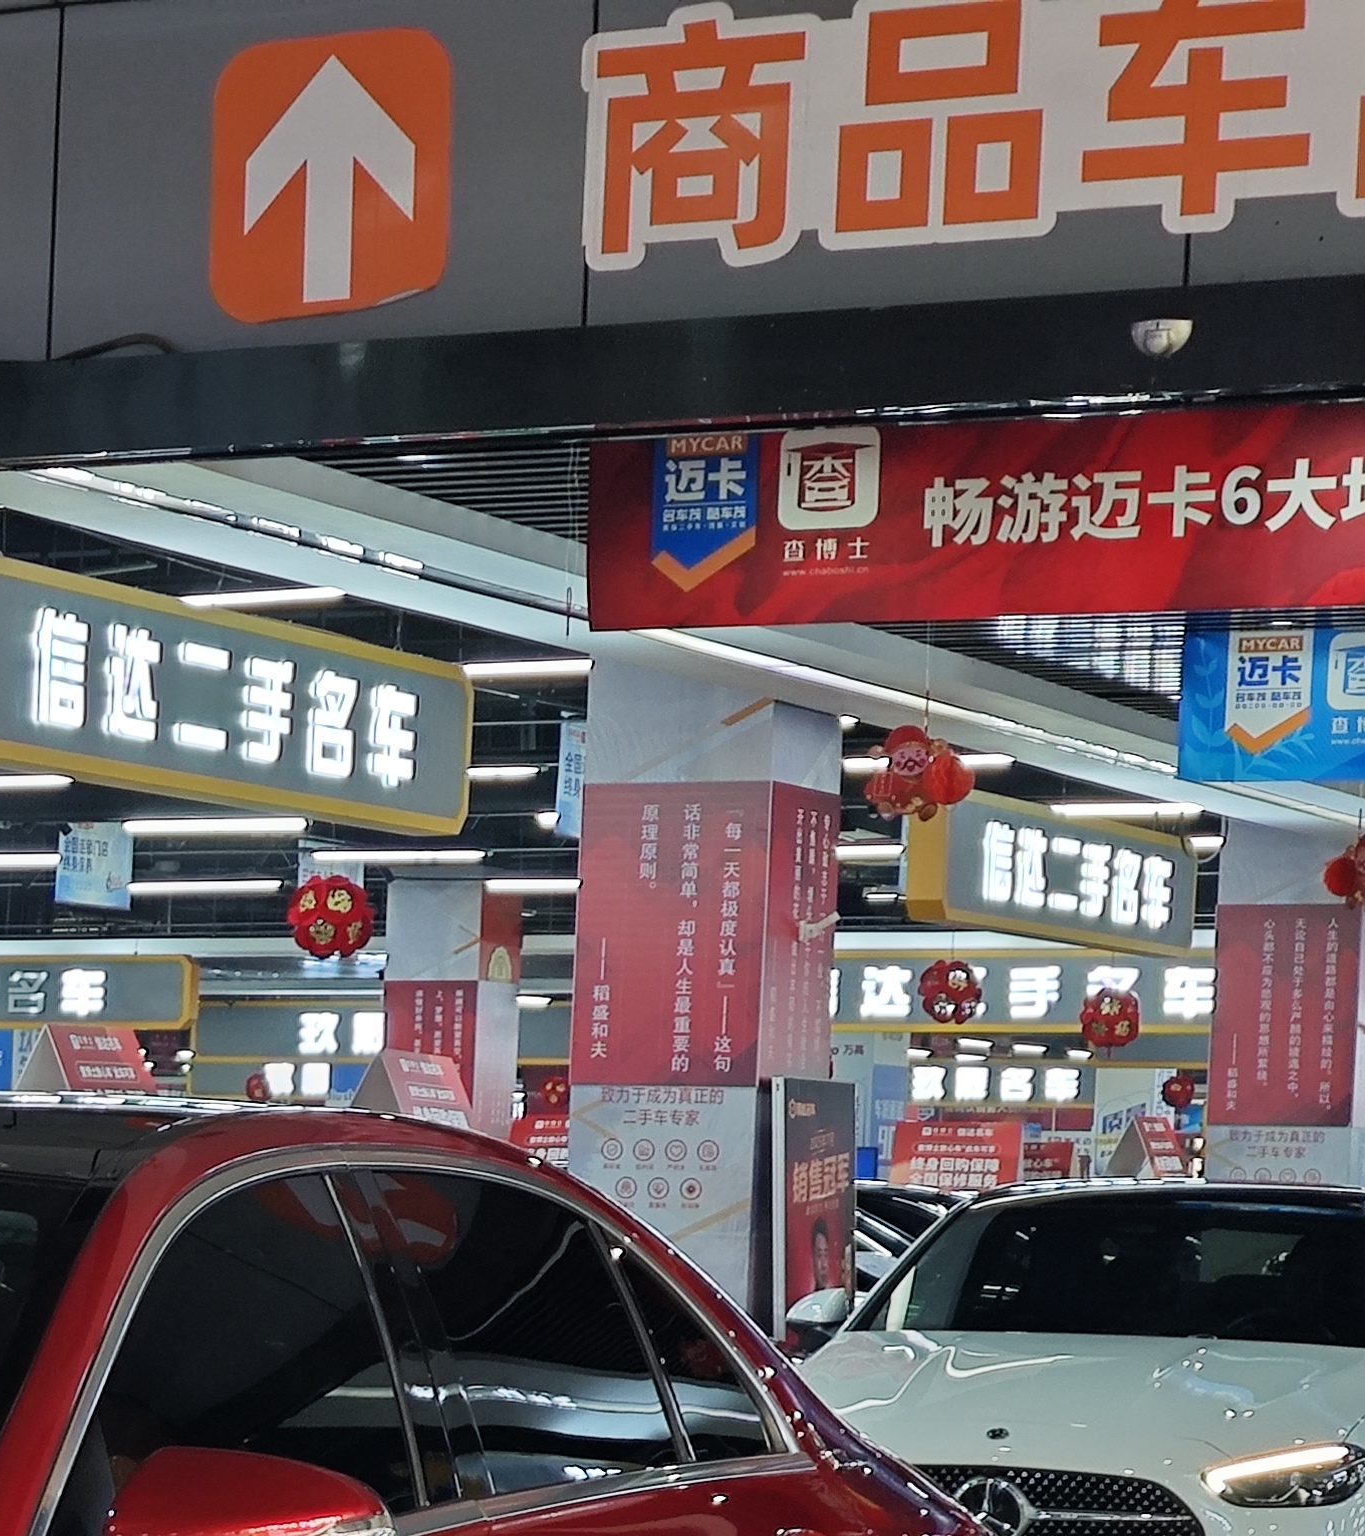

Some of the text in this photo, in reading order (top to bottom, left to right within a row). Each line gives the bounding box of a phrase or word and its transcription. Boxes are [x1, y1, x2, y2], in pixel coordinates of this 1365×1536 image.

[597, 0, 1365, 255] 商品车
[671, 435, 743, 453] MYCAR
[665, 458, 747, 503] 迈卡
[783, 536, 870, 562] 查博士
[783, 565, 869, 577] www.chaboshi.cn
[1241, 637, 1301, 651] MYCAR
[1237, 655, 1302, 687] 迈卡
[33, 606, 419, 787] 信达二手名车
[639, 804, 660, 889] 原理原则。
[982, 820, 1175, 929] 信达二手名车
[671, 804, 702, 1073] 话非常简单，却是人生最重要的
[601, 1086, 724, 1105] 致力于成为真正的
[623, 1109, 700, 1127] 二手车专家
[1229, 1129, 1325, 1144] 致力于成为真正的
[1246, 1145, 1306, 1159] 二手车专家
[909, 1156, 1000, 1172] 终身回购保障
[909, 1173, 998, 1188] 全国保修服务
